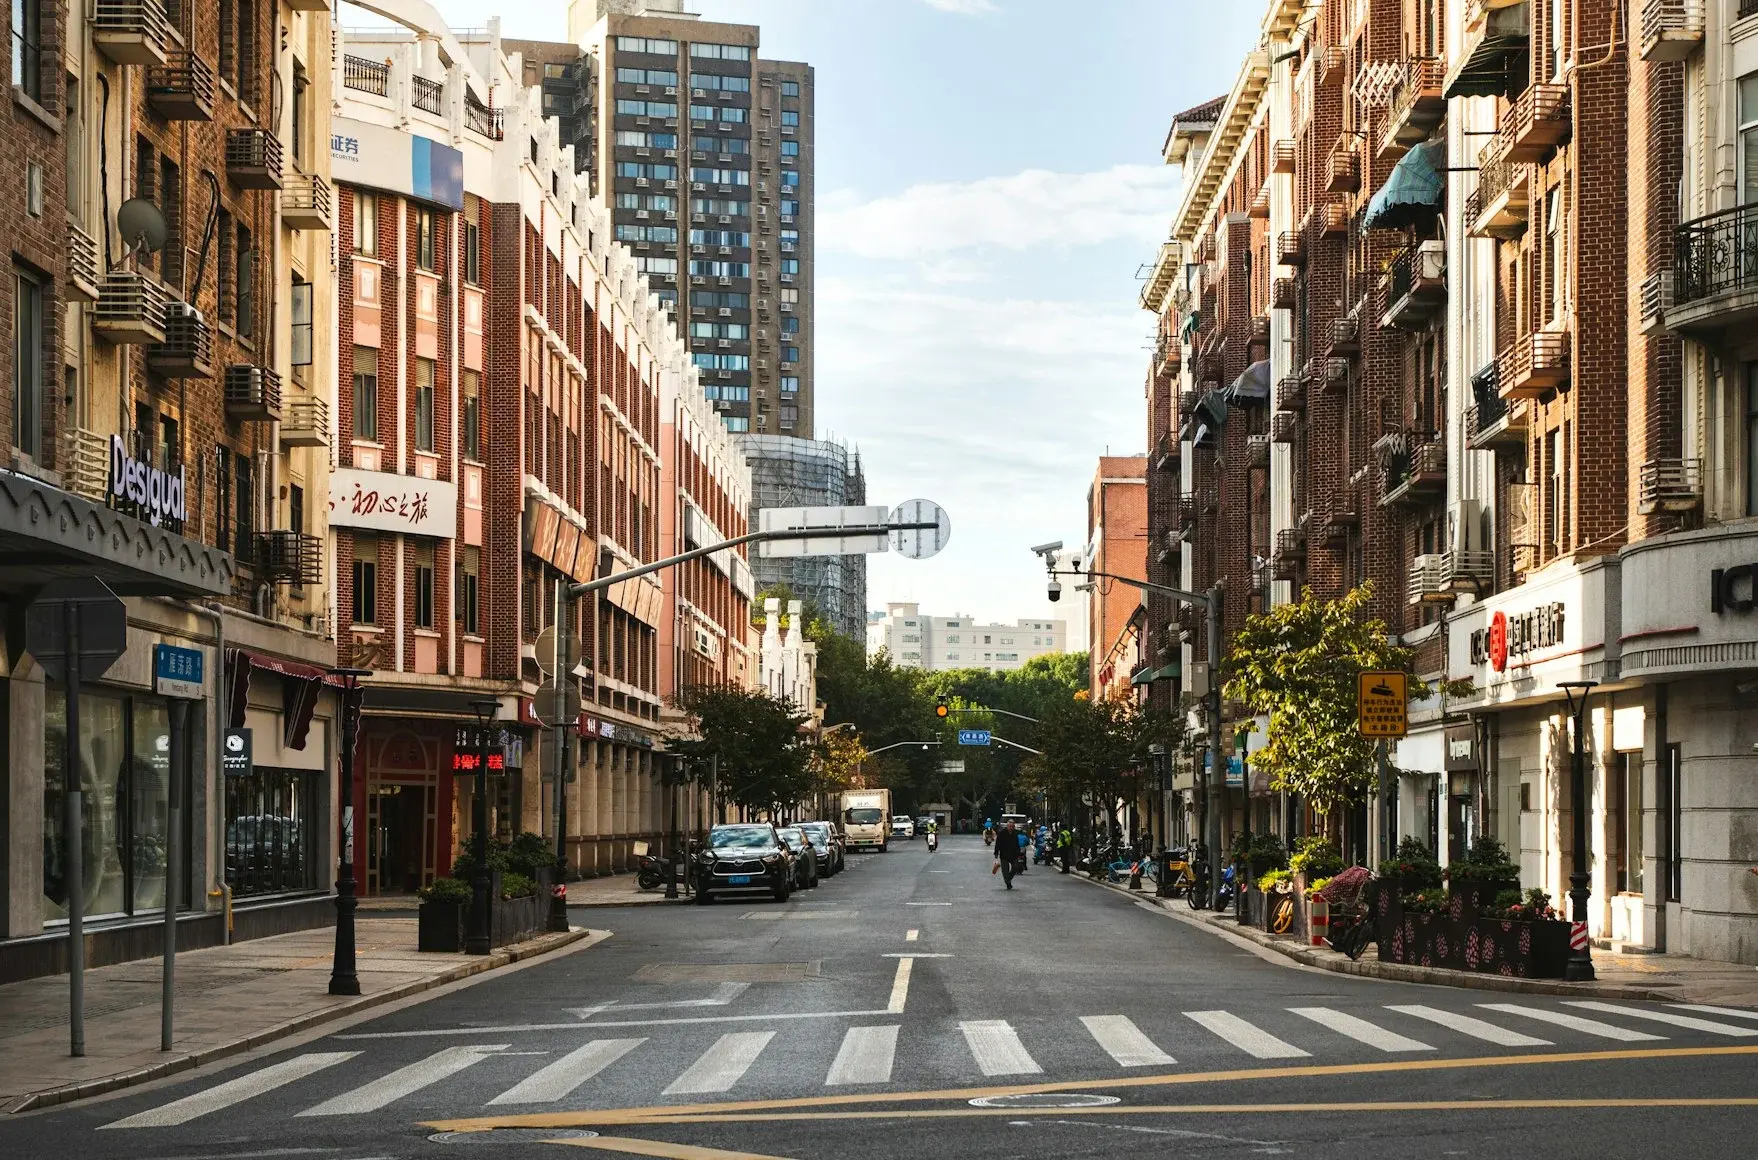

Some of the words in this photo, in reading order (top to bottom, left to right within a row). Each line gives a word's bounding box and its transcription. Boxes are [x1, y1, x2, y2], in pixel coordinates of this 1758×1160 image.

[331, 134, 358, 155] 证券
[331, 152, 359, 163] ECURITIES
[1711, 563, 1758, 614] IC
